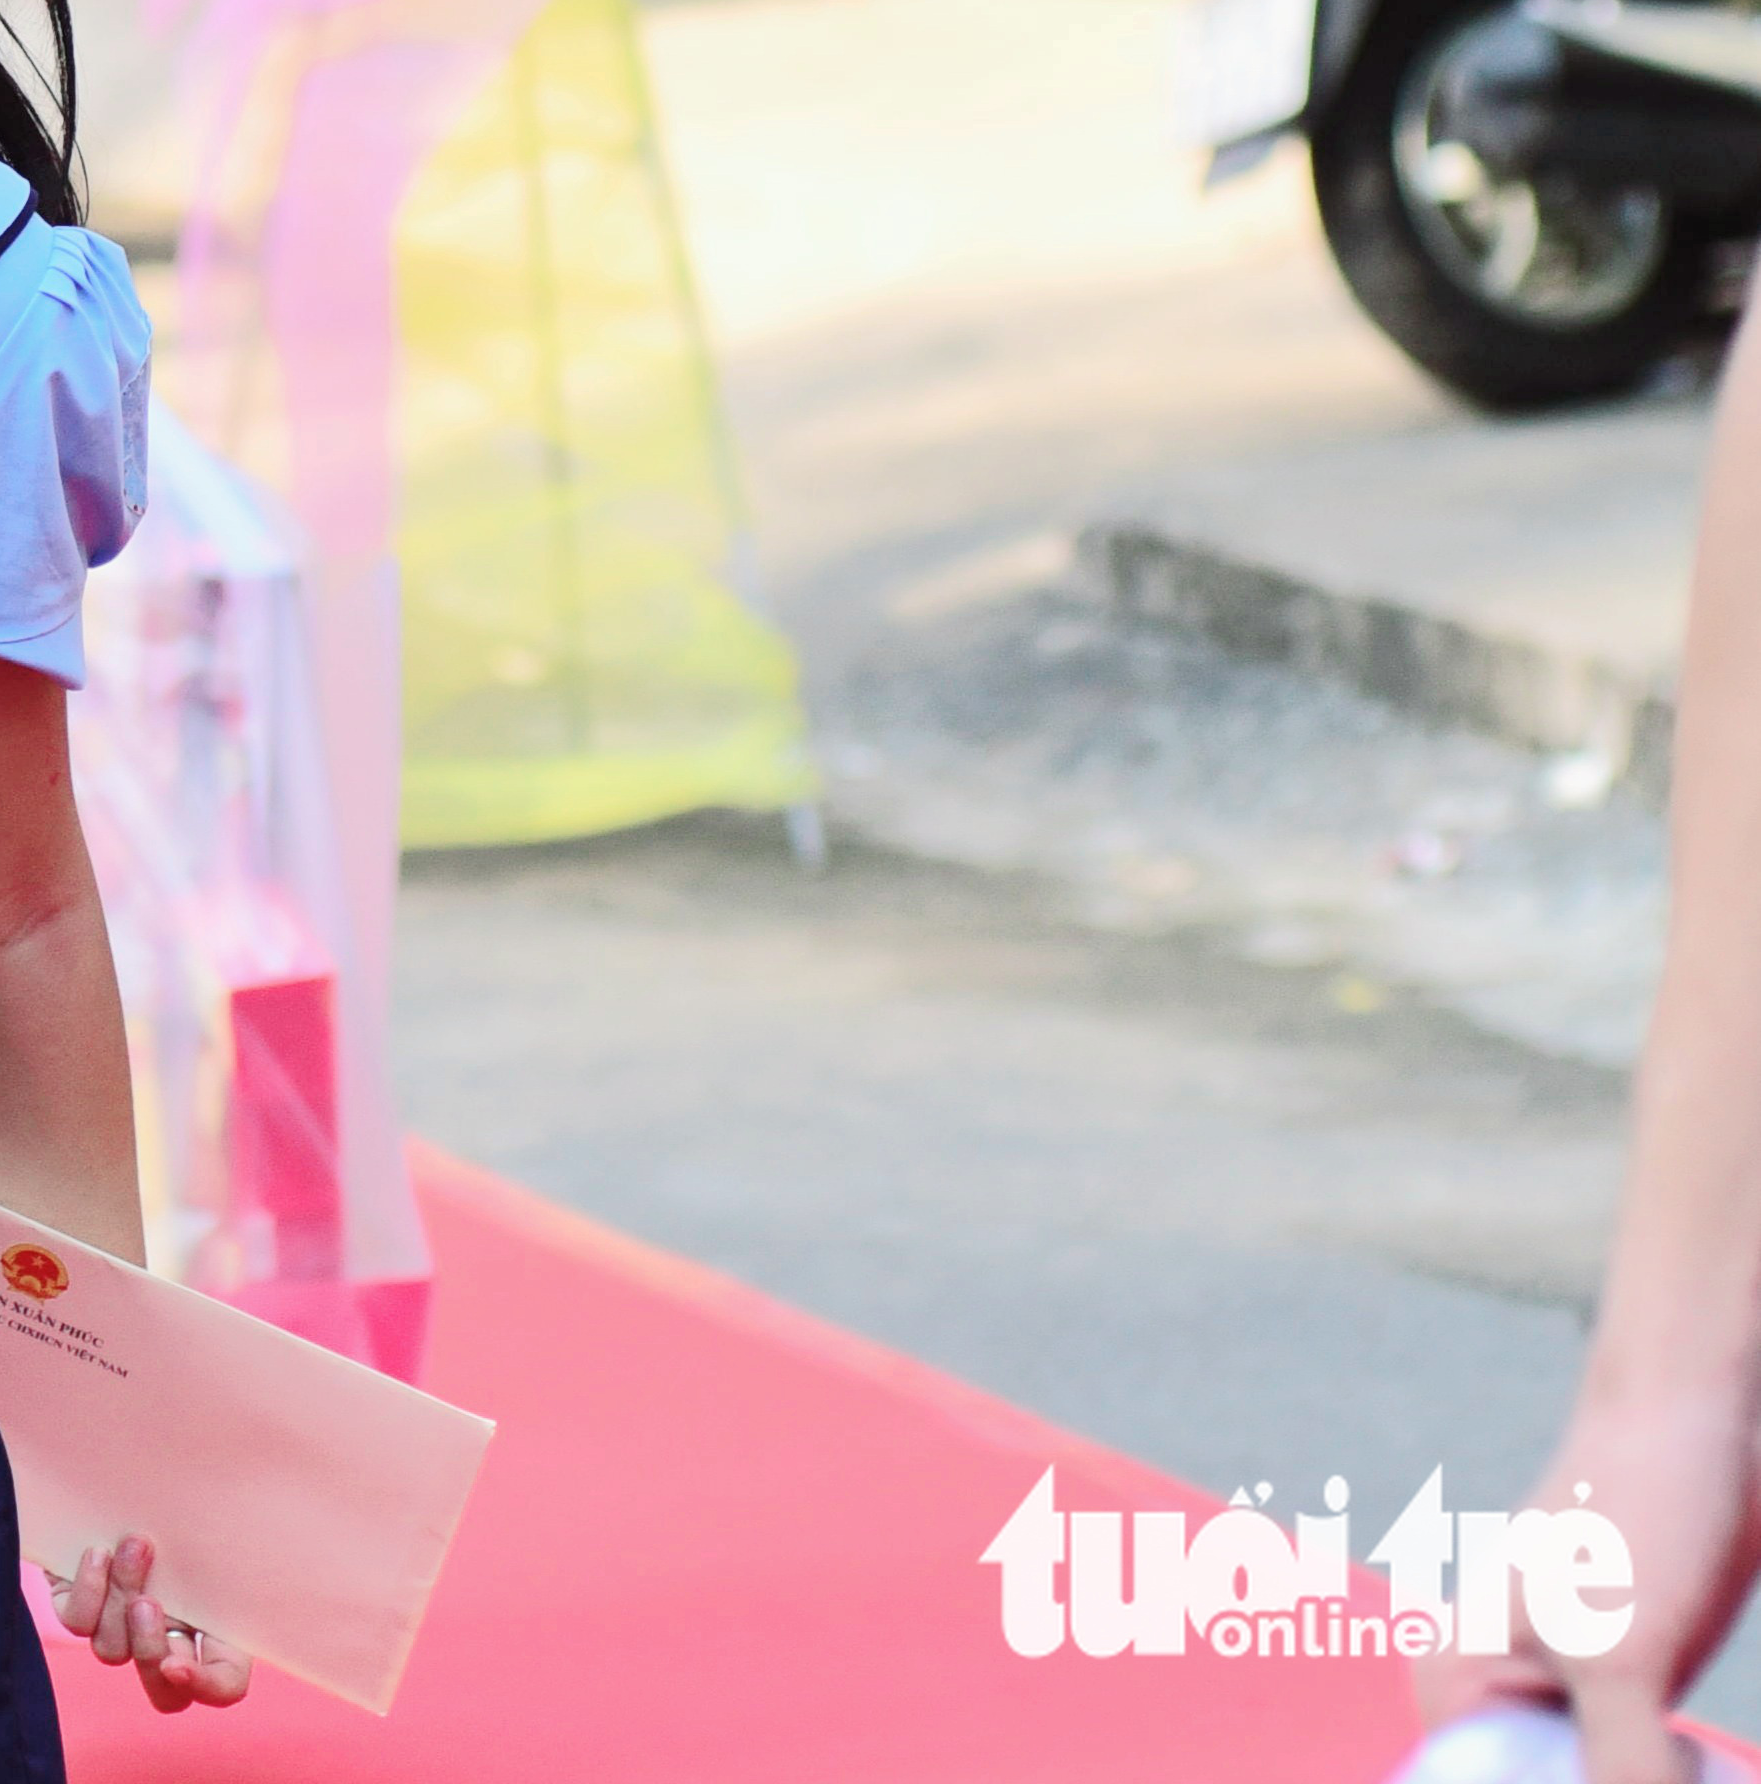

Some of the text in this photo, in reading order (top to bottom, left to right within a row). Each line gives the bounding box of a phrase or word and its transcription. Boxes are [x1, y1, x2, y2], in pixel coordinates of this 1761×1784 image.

[11, 1300, 57, 1328] XUÂN
[59, 1322, 105, 1349] PHÚC
[98, 1357, 129, 1378] NAM
